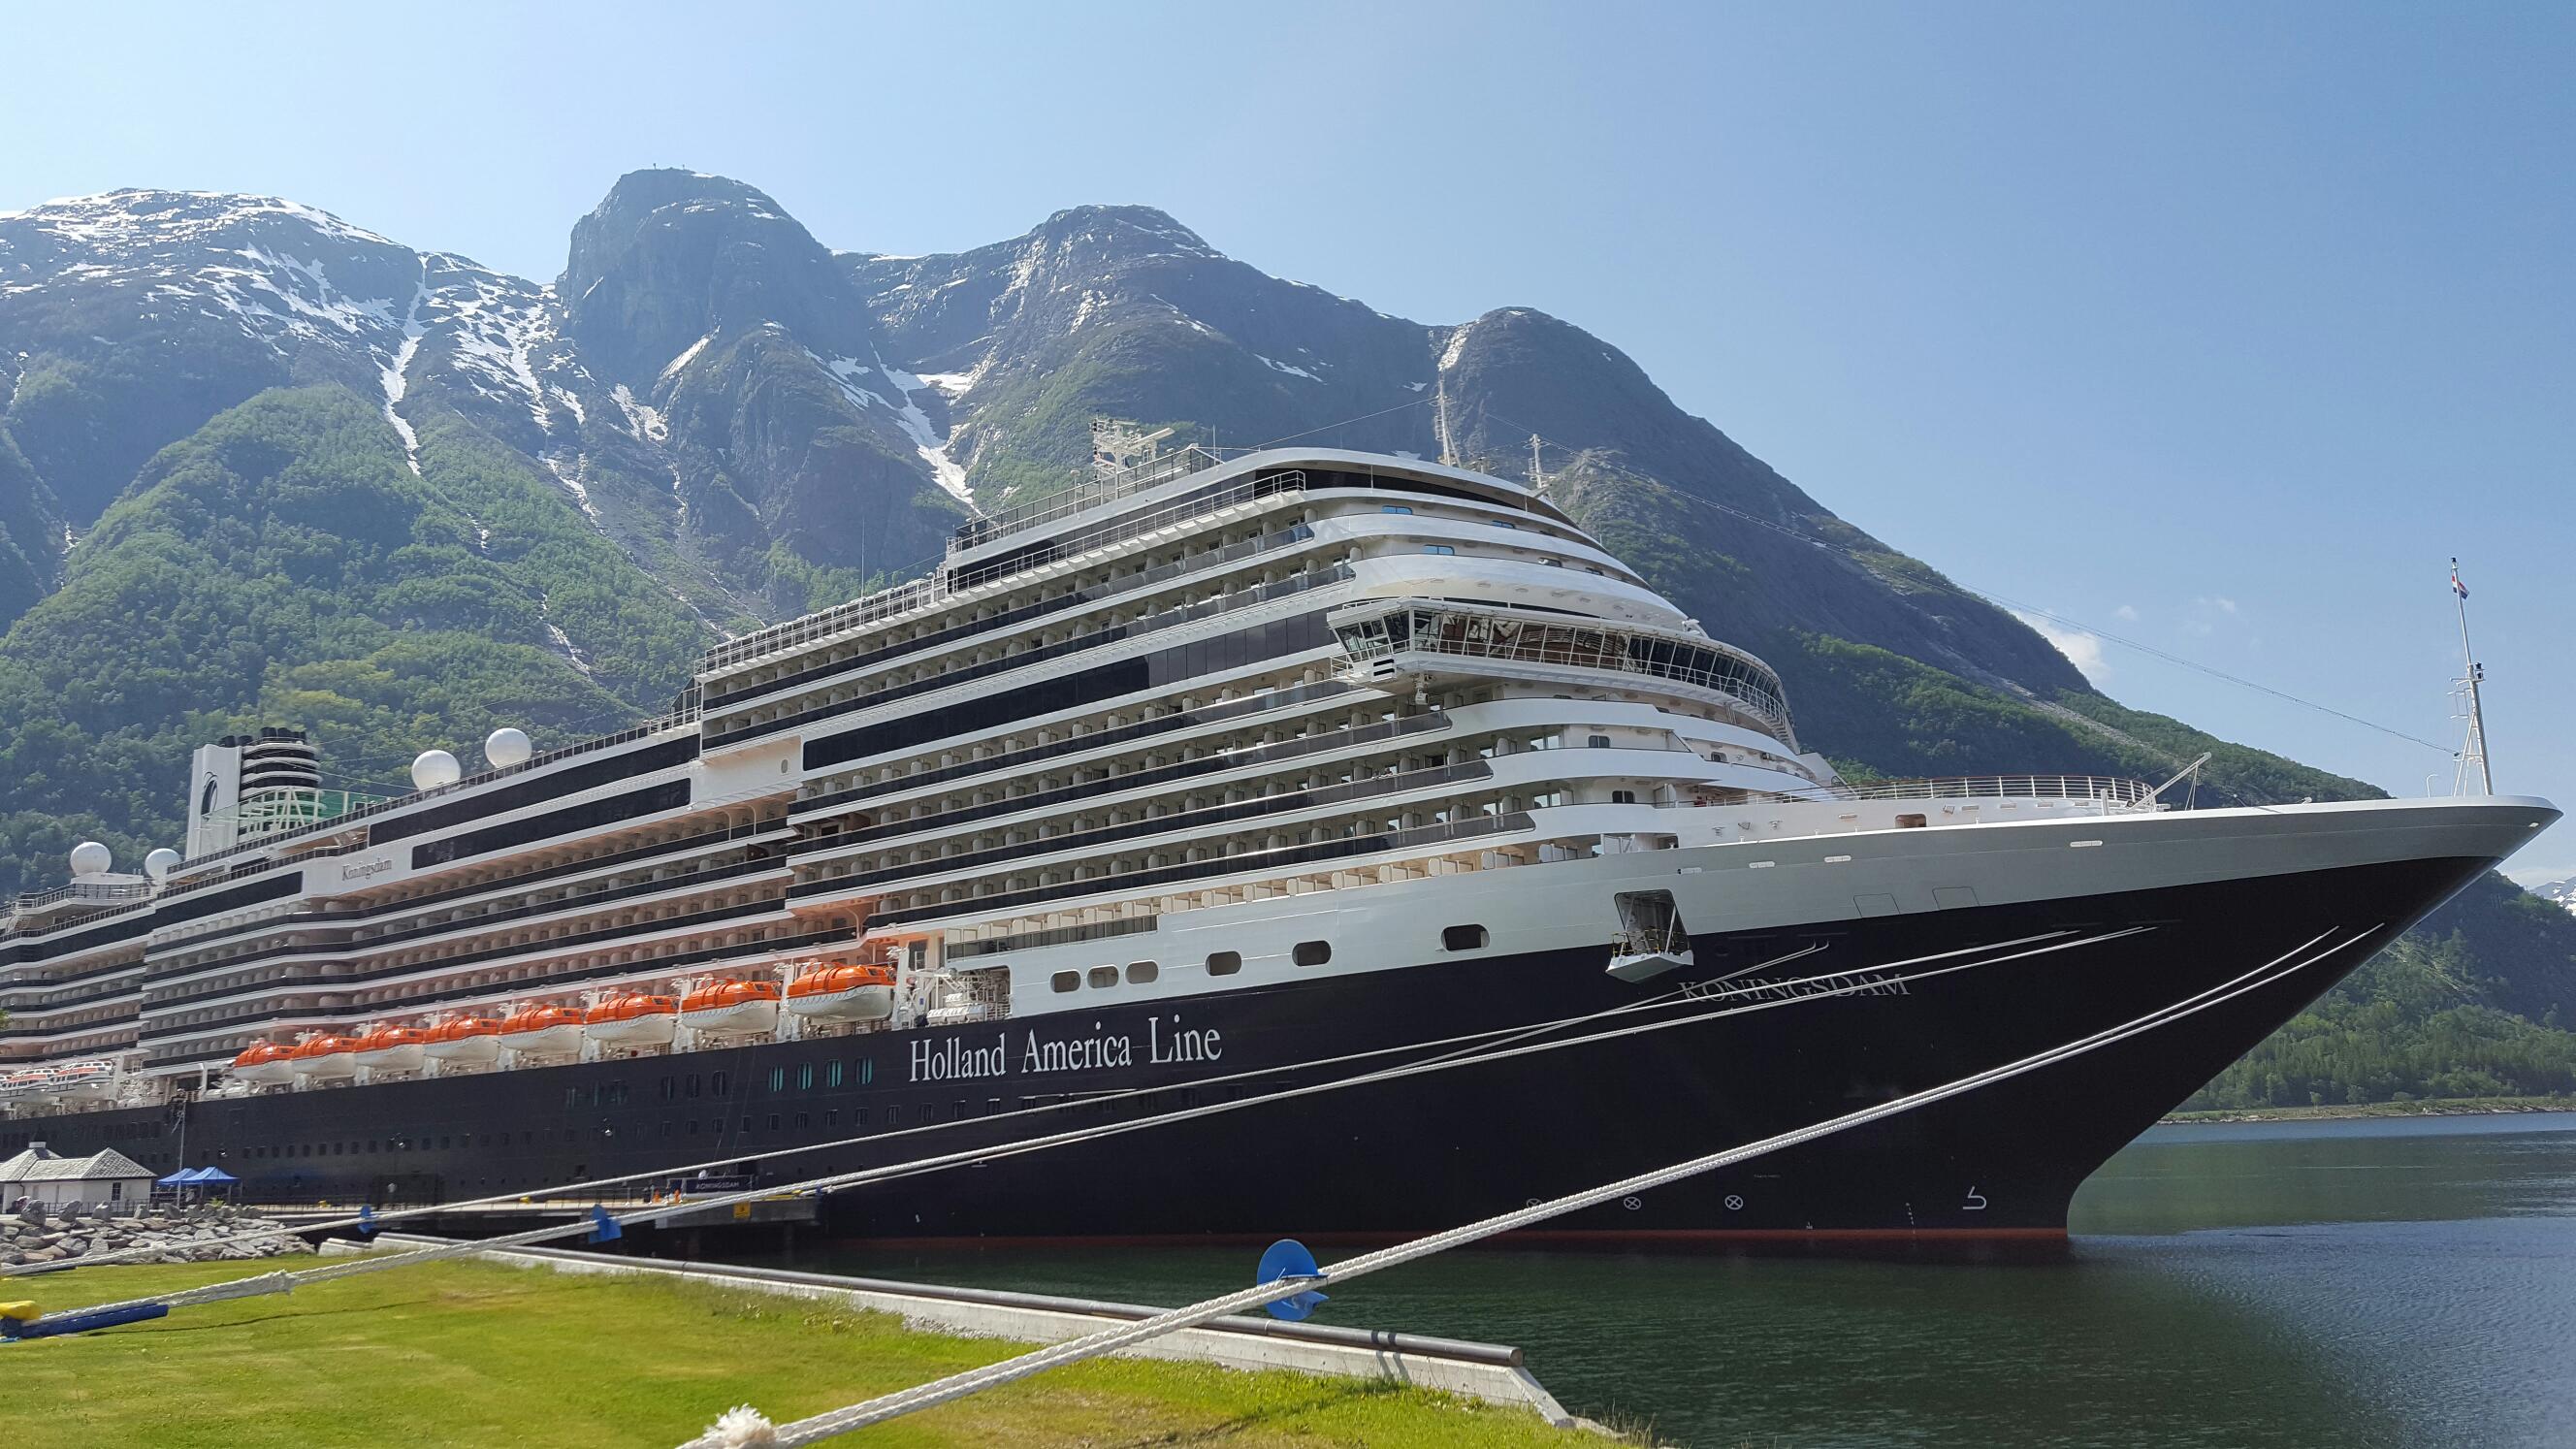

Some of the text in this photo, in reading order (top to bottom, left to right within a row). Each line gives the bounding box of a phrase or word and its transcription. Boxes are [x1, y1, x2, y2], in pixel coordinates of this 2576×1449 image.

[1677, 973, 1912, 1002] KONINGSDAM
[909, 1014, 1223, 1082] Holland America Line
